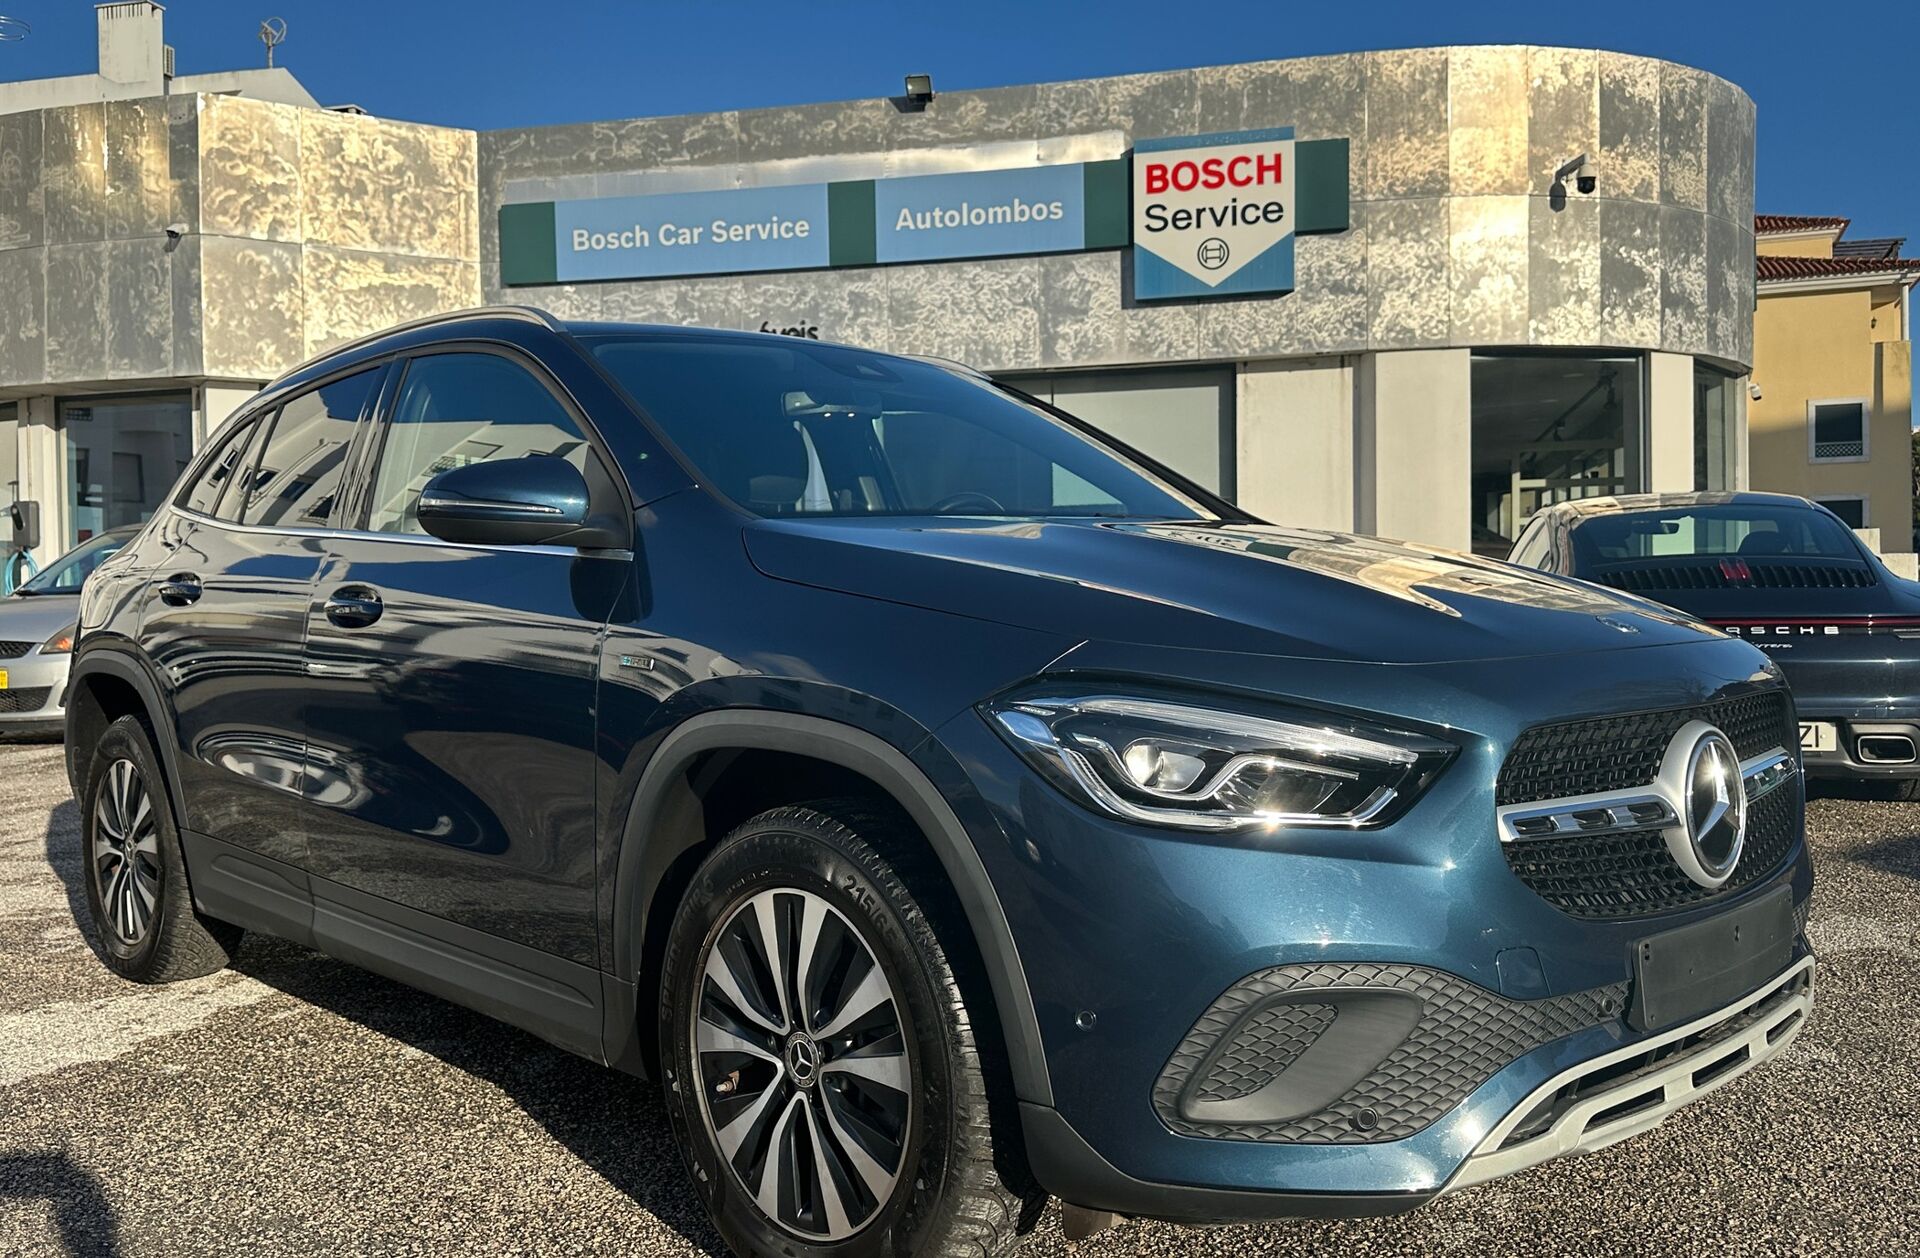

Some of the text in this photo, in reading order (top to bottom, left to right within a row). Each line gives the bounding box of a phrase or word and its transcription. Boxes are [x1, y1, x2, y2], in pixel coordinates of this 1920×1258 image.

[1146, 153, 1282, 194] BOSCH
[895, 198, 1064, 231] Autolombos
[1144, 198, 1284, 232] Service
[573, 216, 810, 251] Bosch Car Service
[1725, 626, 1840, 635] RSCHE
